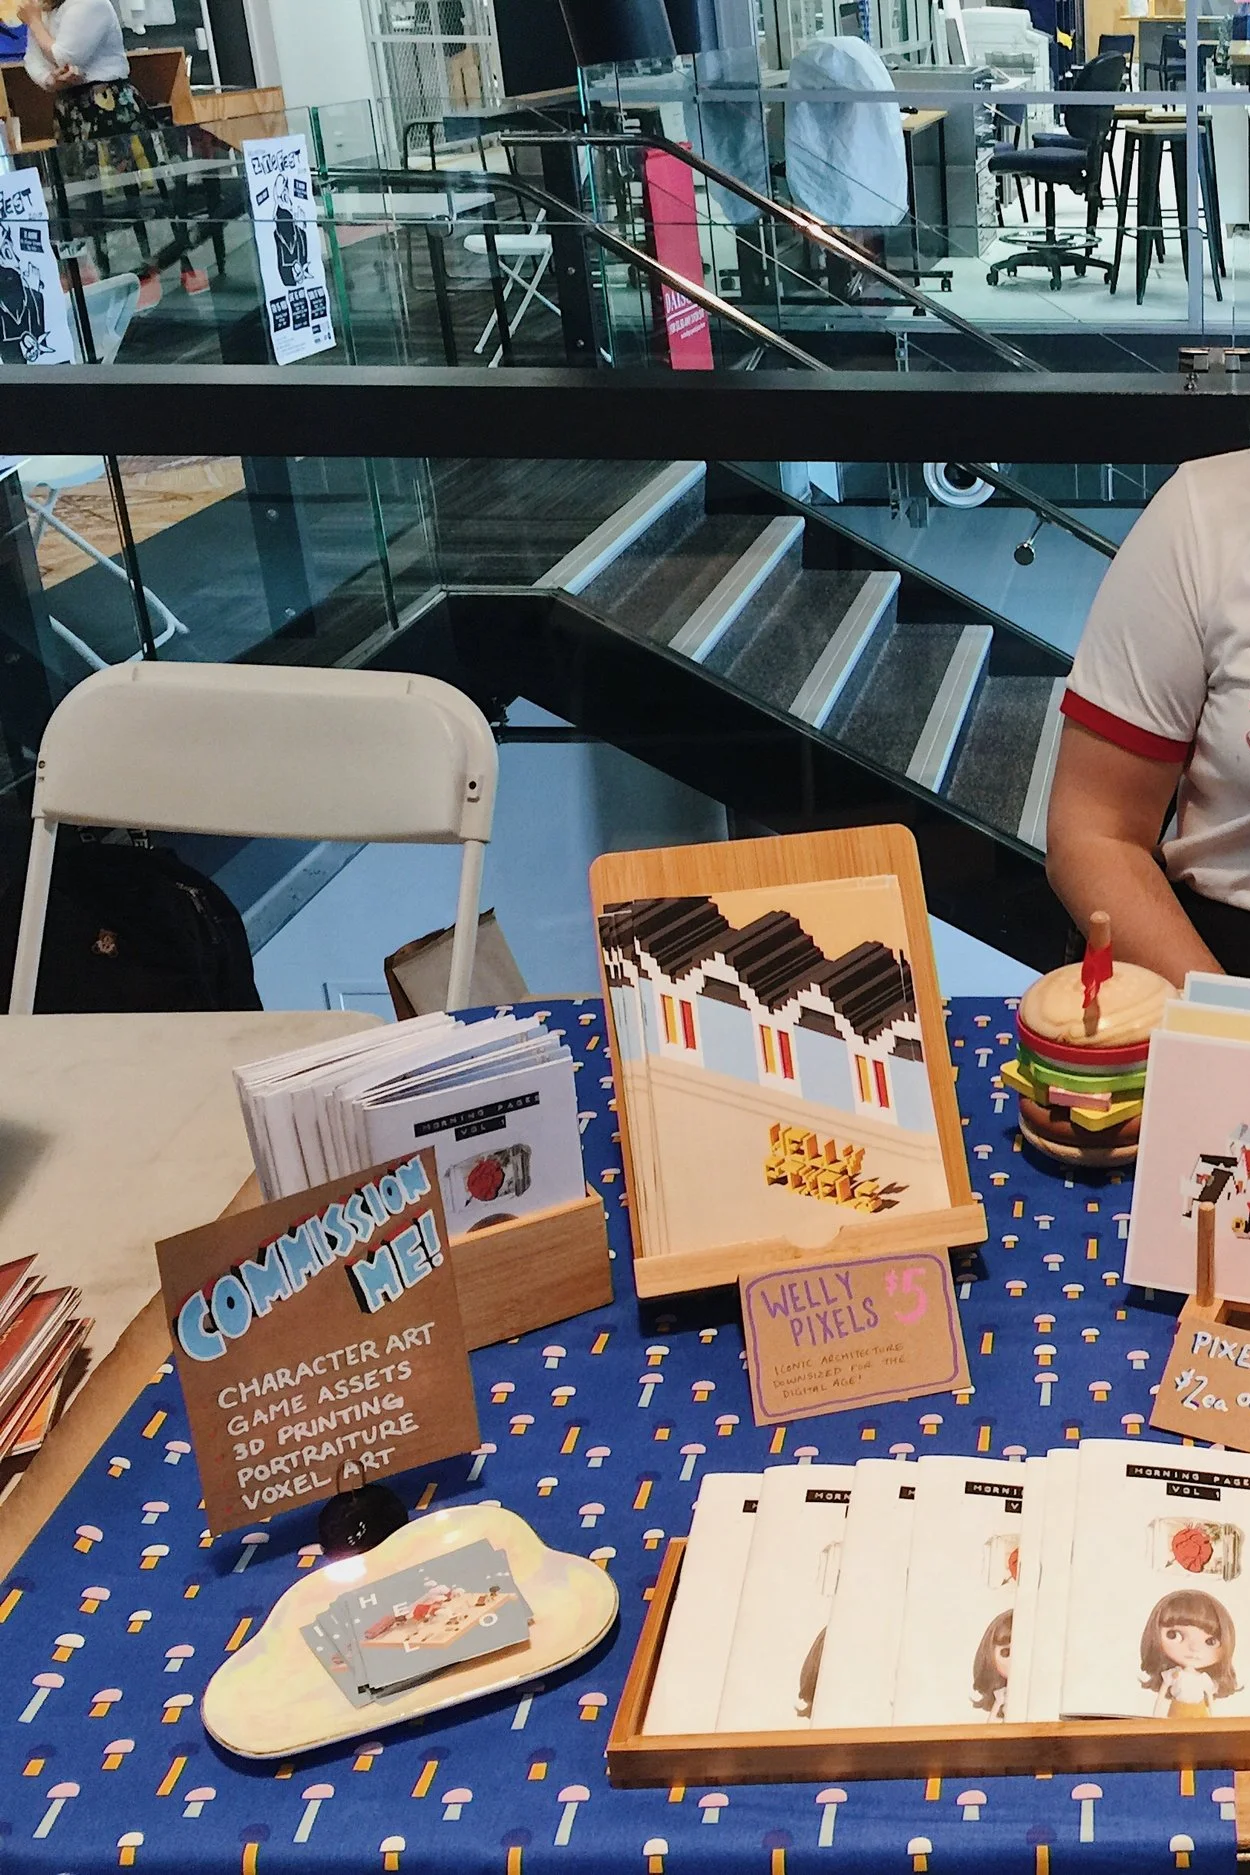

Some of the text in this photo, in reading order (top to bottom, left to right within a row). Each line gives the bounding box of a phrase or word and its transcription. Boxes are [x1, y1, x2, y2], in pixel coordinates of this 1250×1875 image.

[421, 1109, 485, 1132] MORNING
[460, 1123, 486, 1137] VOL
[174, 1154, 431, 1362] COMMISSION
[348, 1209, 444, 1314] ME!
[760, 1267, 928, 1326] WELLY $5
[789, 1296, 880, 1348] PIXELS
[217, 1321, 435, 1410] CHARACTER ART
[773, 1367, 842, 1389] DOWNSIZED
[884, 1355, 906, 1366] THE
[1174, 1368, 1229, 1413] $2ea
[227, 1360, 413, 1437] GAME ASSETS
[783, 1385, 827, 1399] DIGITAL
[233, 1393, 405, 1461] 3D PRINTING
[237, 1412, 420, 1490] PORTRAITURE
[241, 1447, 396, 1511] VOXEL ART
[973, 1484, 1023, 1496] MORNI
[1134, 1467, 1200, 1480] MORNING
[1172, 1485, 1200, 1496] VOL
